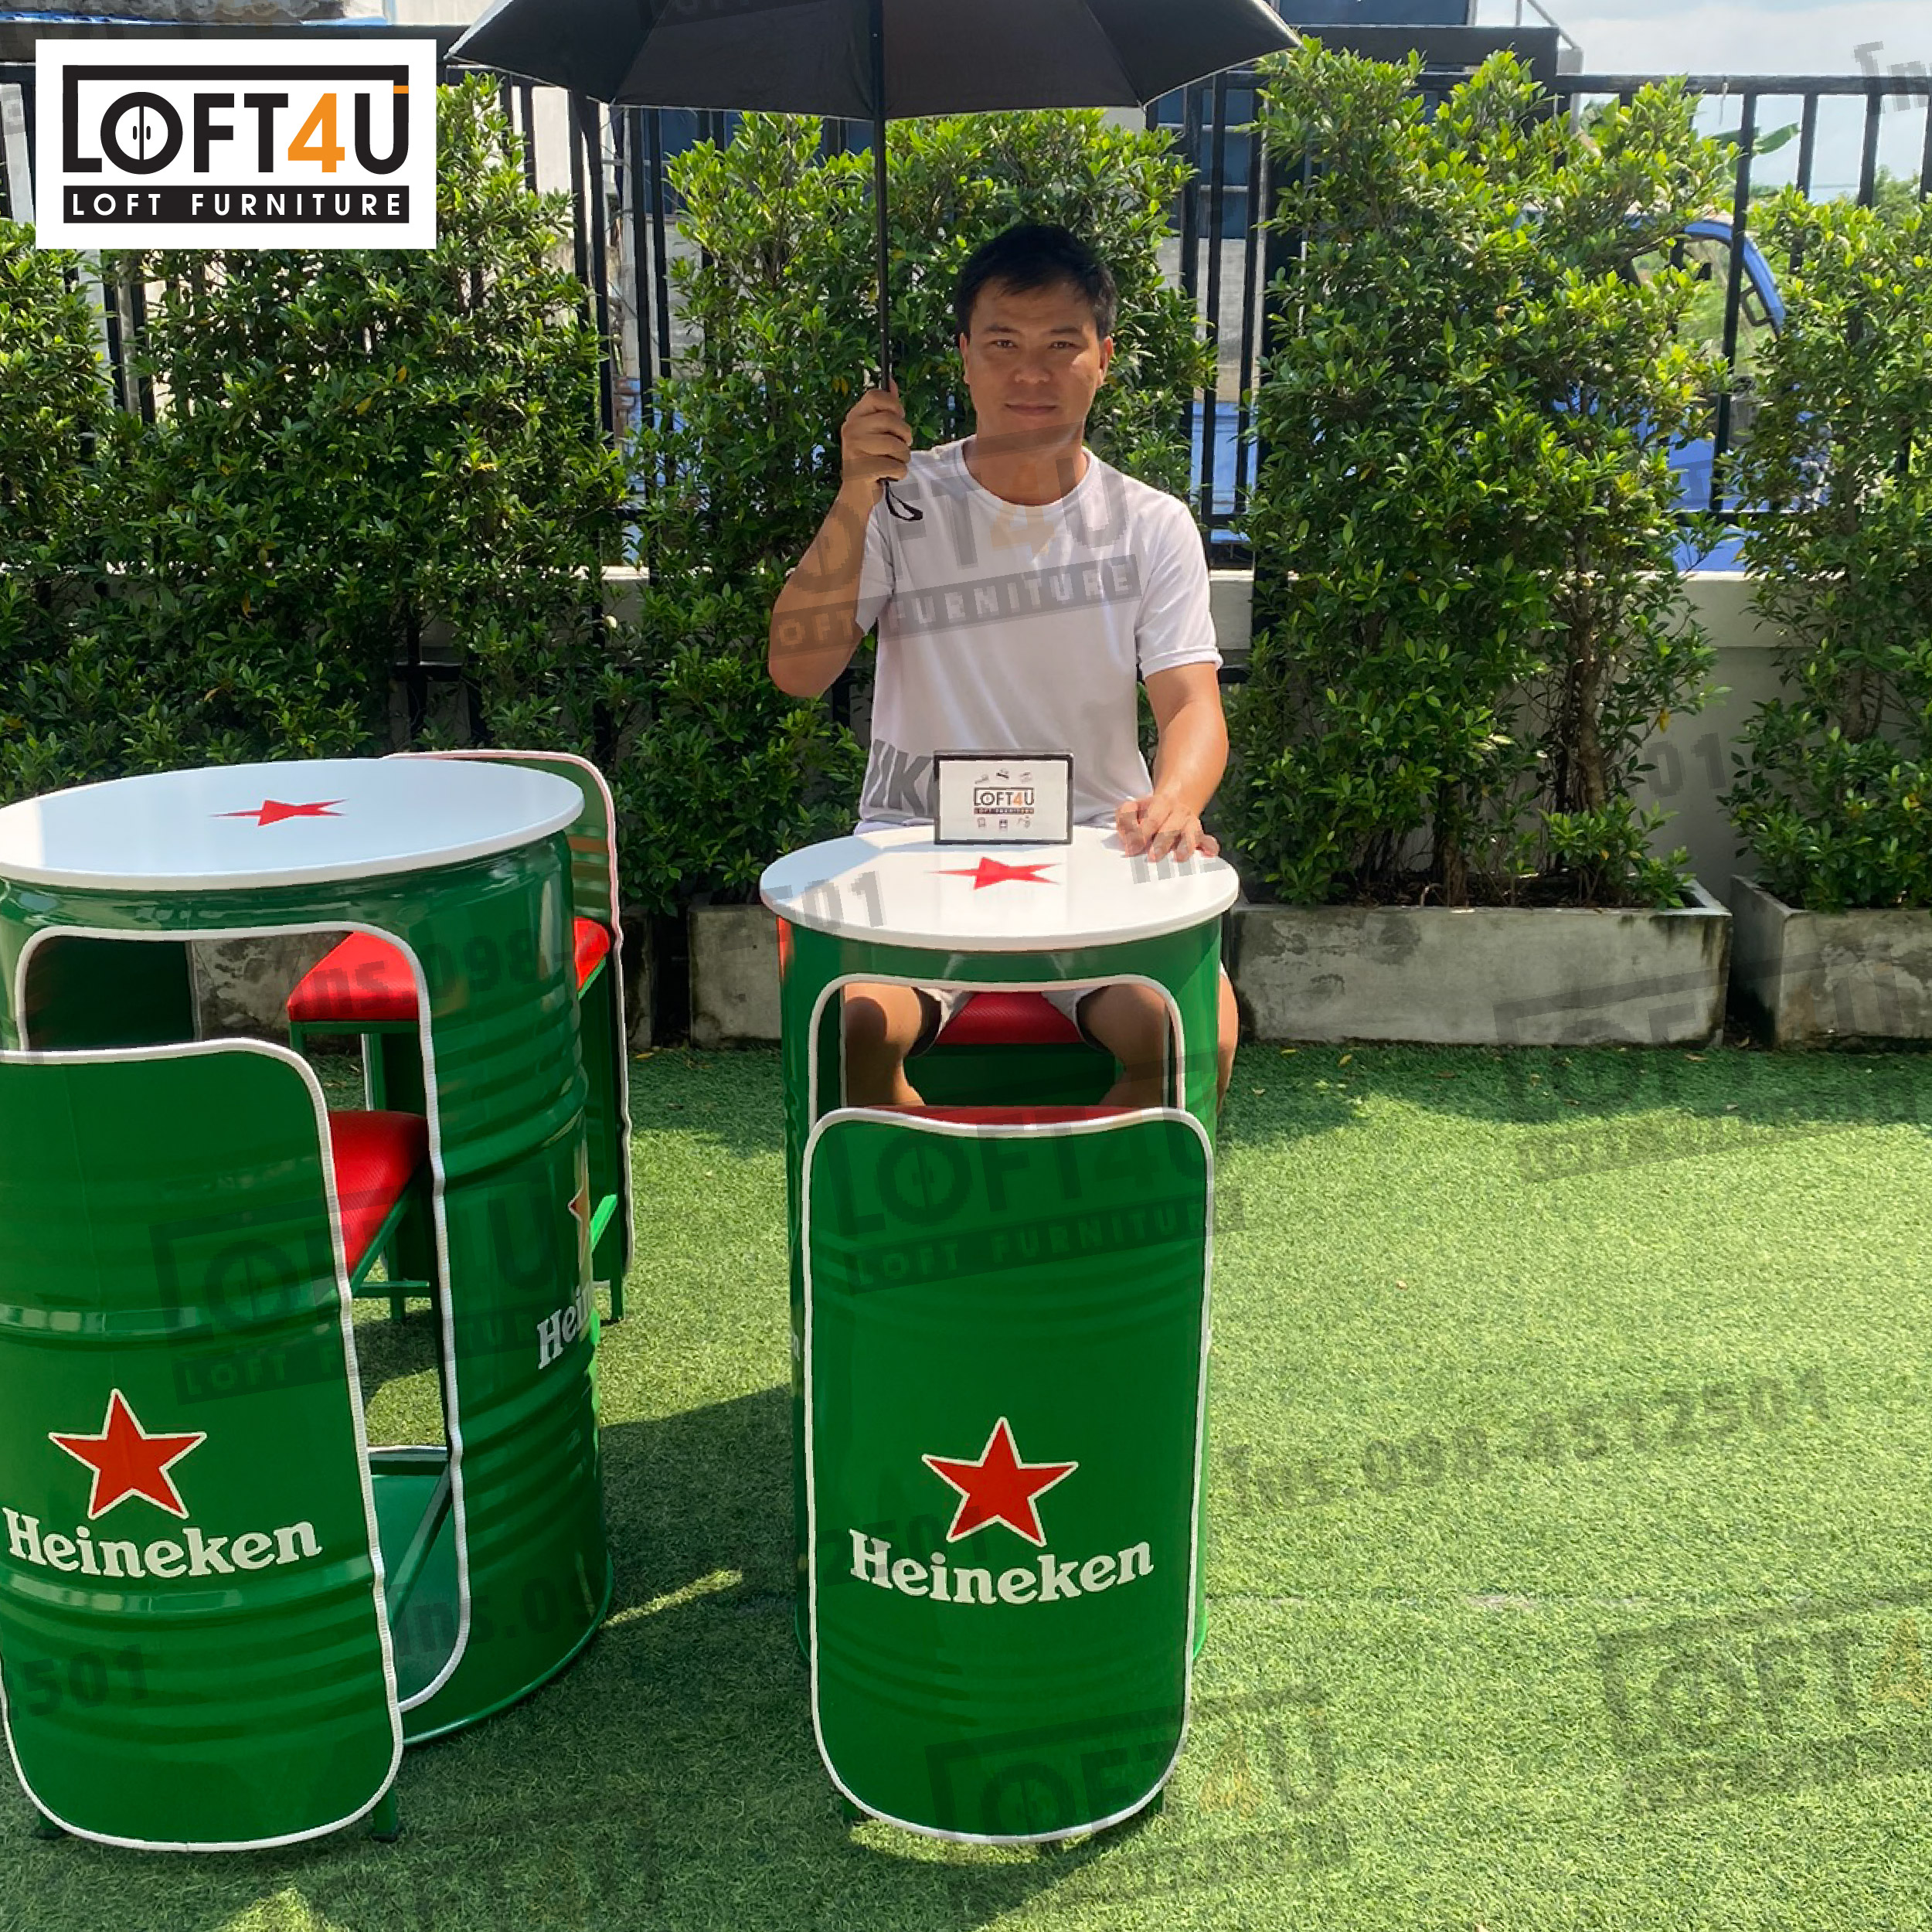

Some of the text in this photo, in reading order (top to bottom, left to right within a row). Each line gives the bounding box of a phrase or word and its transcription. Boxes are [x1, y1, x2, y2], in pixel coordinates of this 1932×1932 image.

[974, 787, 1034, 807] LOFT4U
[2, 1506, 322, 1578] Heineken
[849, 1529, 1154, 1605] Heineken
